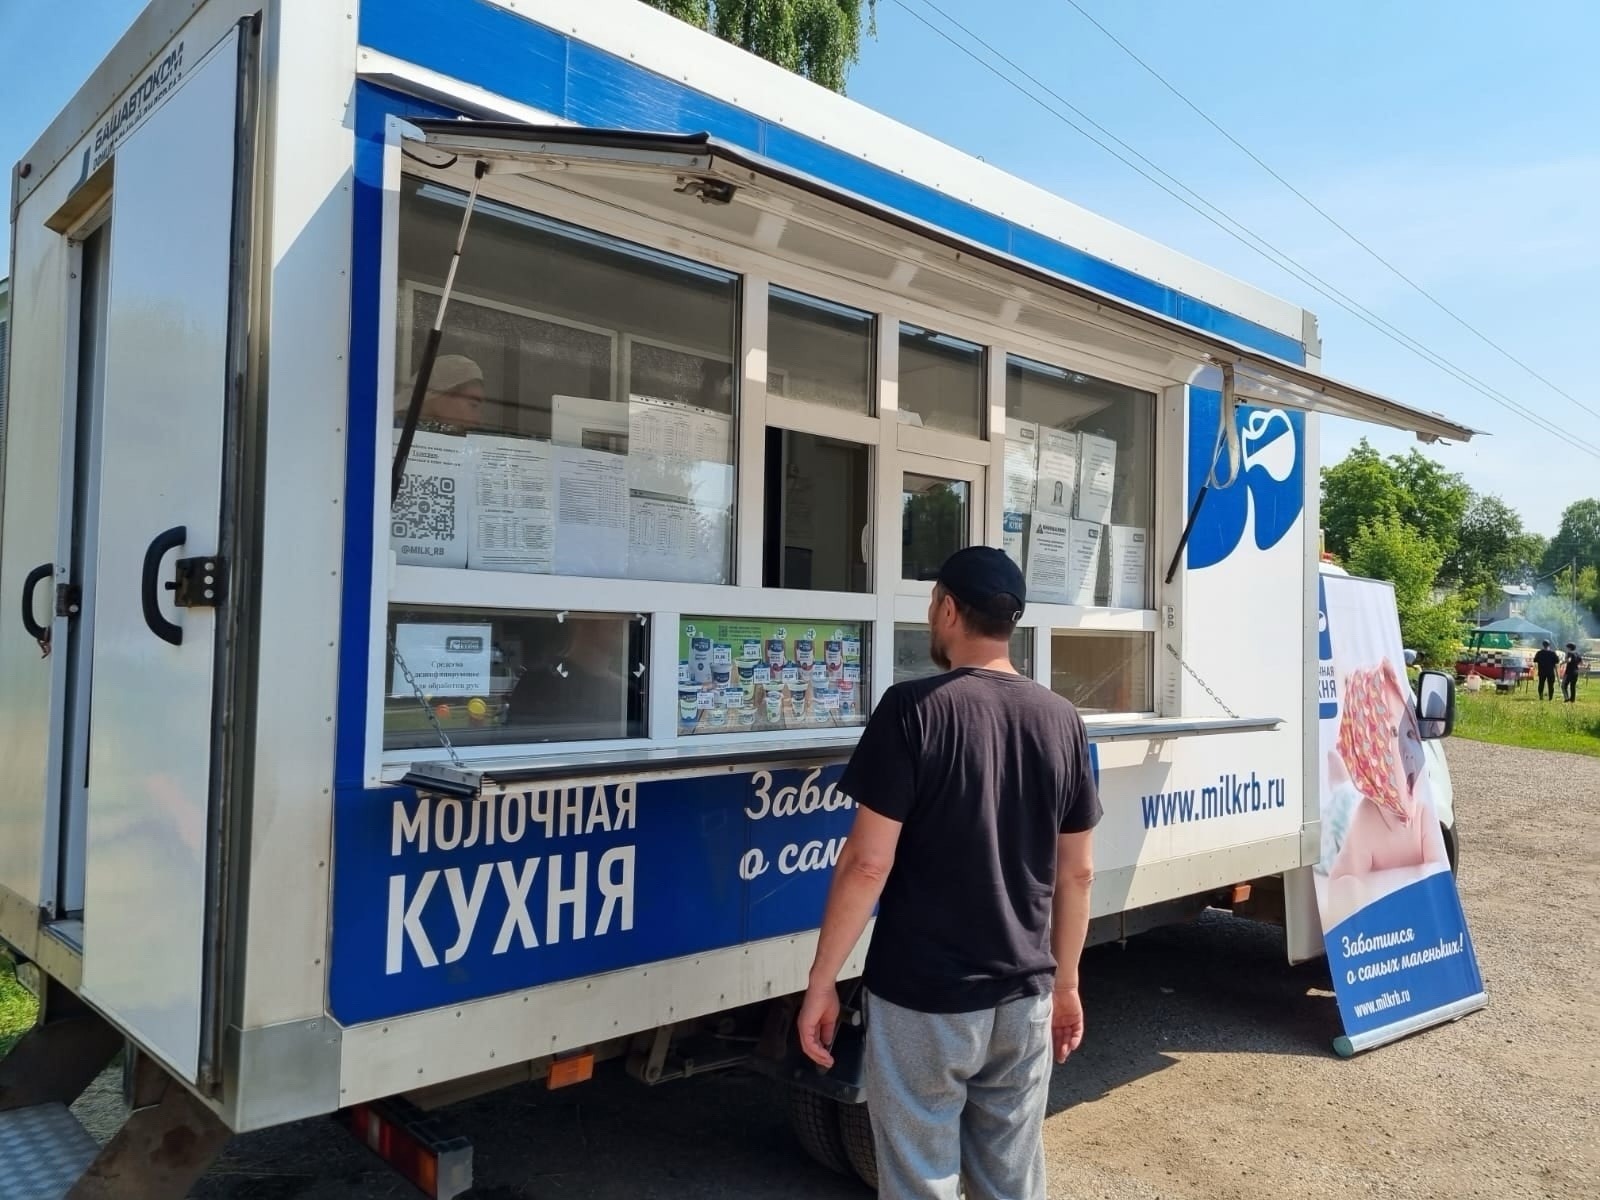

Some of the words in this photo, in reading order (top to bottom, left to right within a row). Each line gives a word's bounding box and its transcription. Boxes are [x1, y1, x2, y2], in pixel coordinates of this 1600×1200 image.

[401, 545, 445, 557] @MILK_RB
[391, 782, 637, 856] МОЛОЧНАЯ
[1141, 772, 1285, 830] www.milkrb.ru
[739, 848, 770, 880] о
[386, 845, 636, 975] КУХНЯ
[1341, 927, 1416, 959] Заботимся
[1346, 968, 1357, 985] о
[1357, 954, 1400, 982] самых
[1401, 932, 1464, 971] маленьких!
[1353, 989, 1411, 1018] www.milkrb.ru
